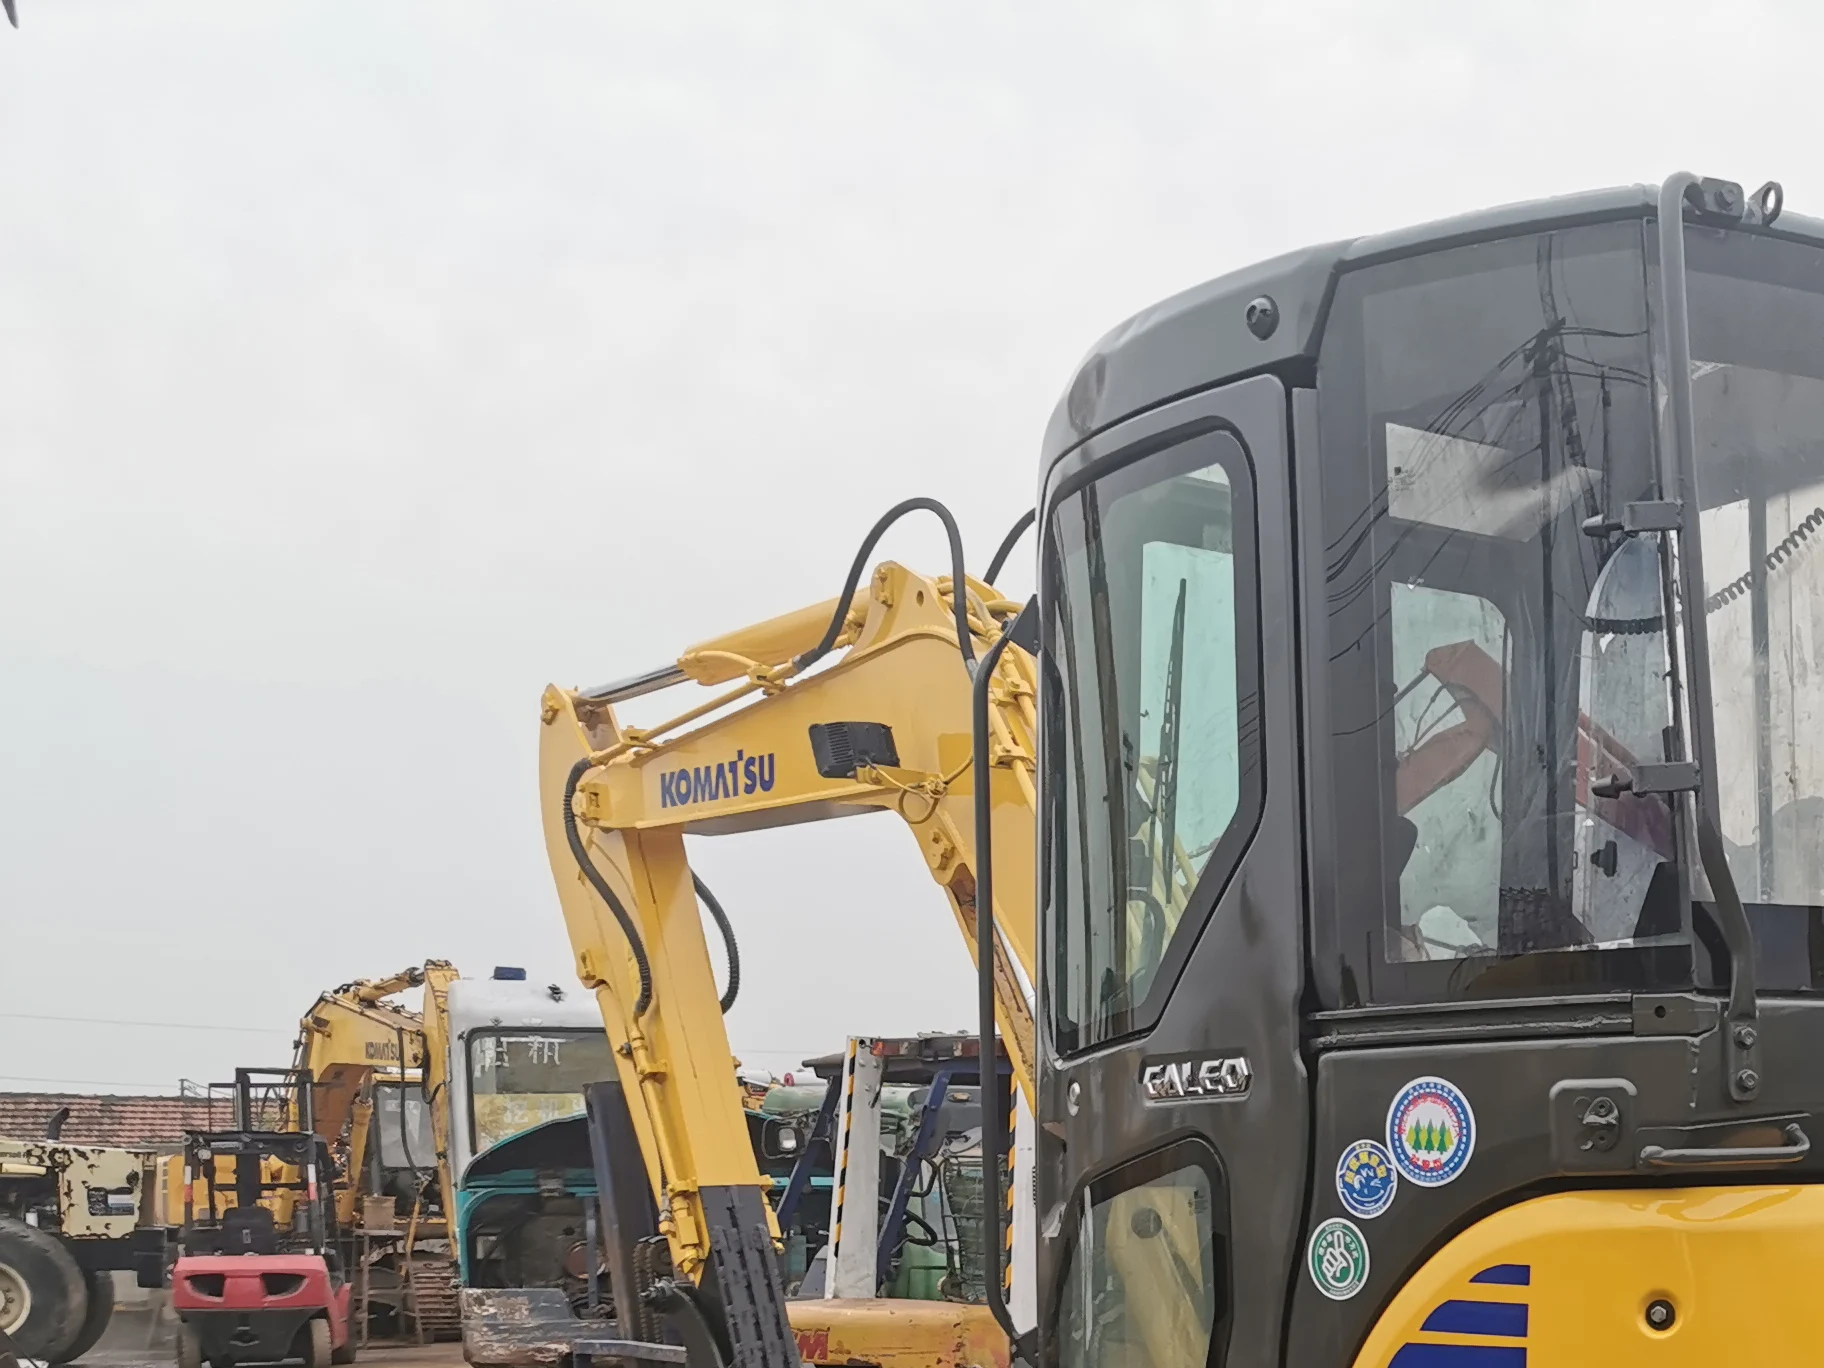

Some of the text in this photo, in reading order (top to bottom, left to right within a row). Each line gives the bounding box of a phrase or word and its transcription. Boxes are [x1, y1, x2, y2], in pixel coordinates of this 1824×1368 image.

[660, 749, 775, 808] KOMATSU
[1143, 1057, 1252, 1096] GALEO
[791, 1331, 829, 1361] M
